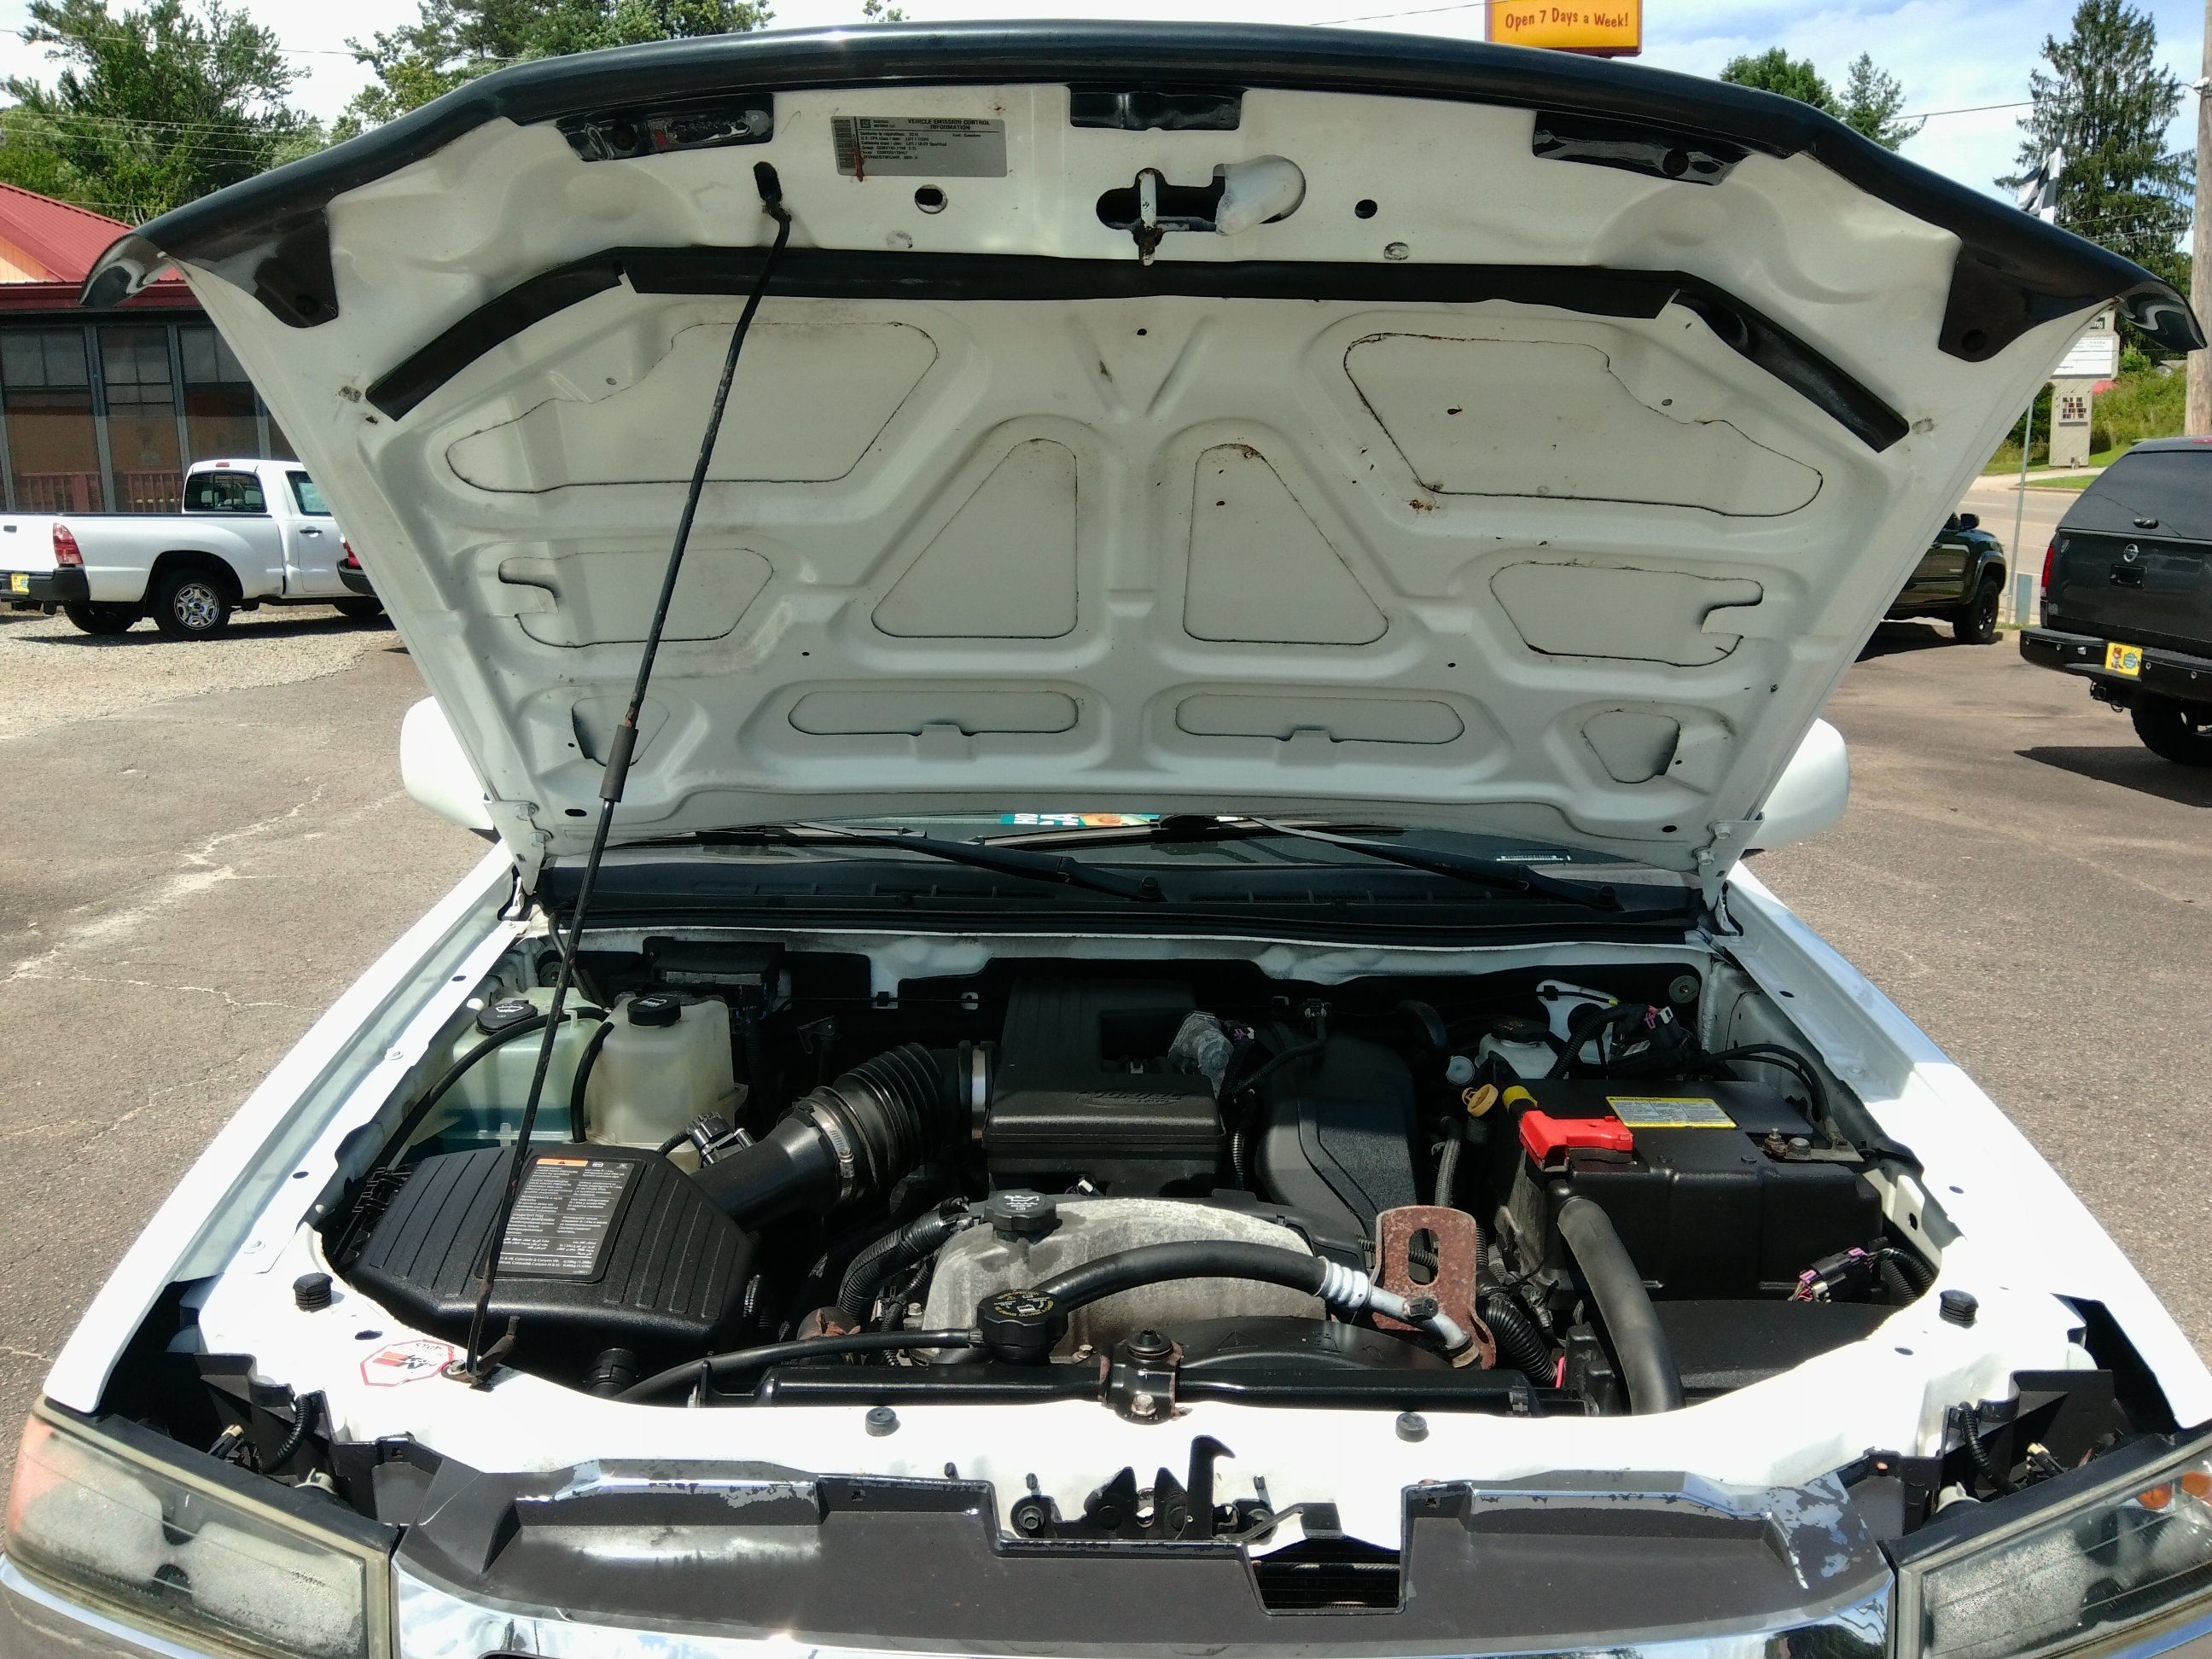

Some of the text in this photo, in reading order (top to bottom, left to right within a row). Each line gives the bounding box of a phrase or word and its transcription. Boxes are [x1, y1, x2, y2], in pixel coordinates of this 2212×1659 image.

[1505, 8, 1628, 32] Open 7 Days a Week!
